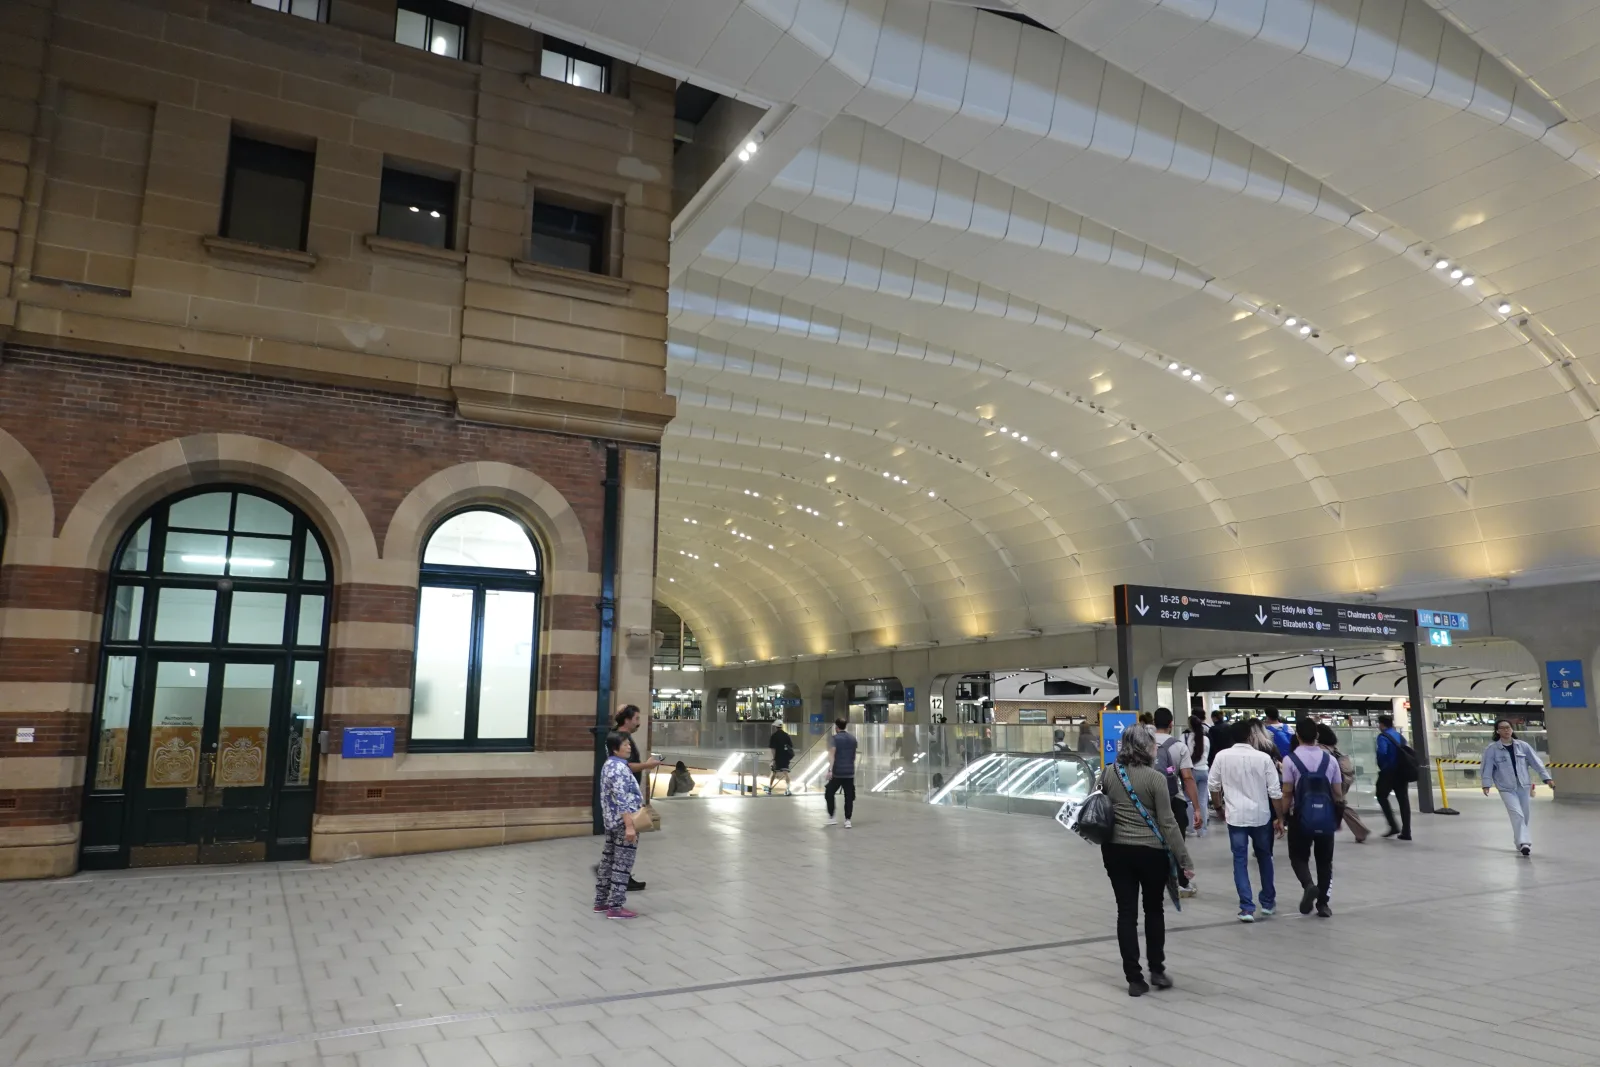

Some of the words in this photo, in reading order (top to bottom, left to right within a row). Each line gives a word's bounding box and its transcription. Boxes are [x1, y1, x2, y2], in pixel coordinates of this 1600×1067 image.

[1160, 595, 1180, 604] 16-25
[1160, 610, 1181, 619] 26-27
[1281, 605, 1295, 615] Eddy
[1296, 606, 1306, 615] Ave
[1347, 610, 1371, 620] Chalmers
[1371, 612, 1377, 620] St
[1420, 613, 1432, 623] Lift
[1282, 619, 1308, 629] Elizabeth
[1308, 621, 1315, 629] St
[1348, 624, 1376, 633] Devonshire
[1376, 626, 1383, 634] St
[932, 698, 943, 710] 12
